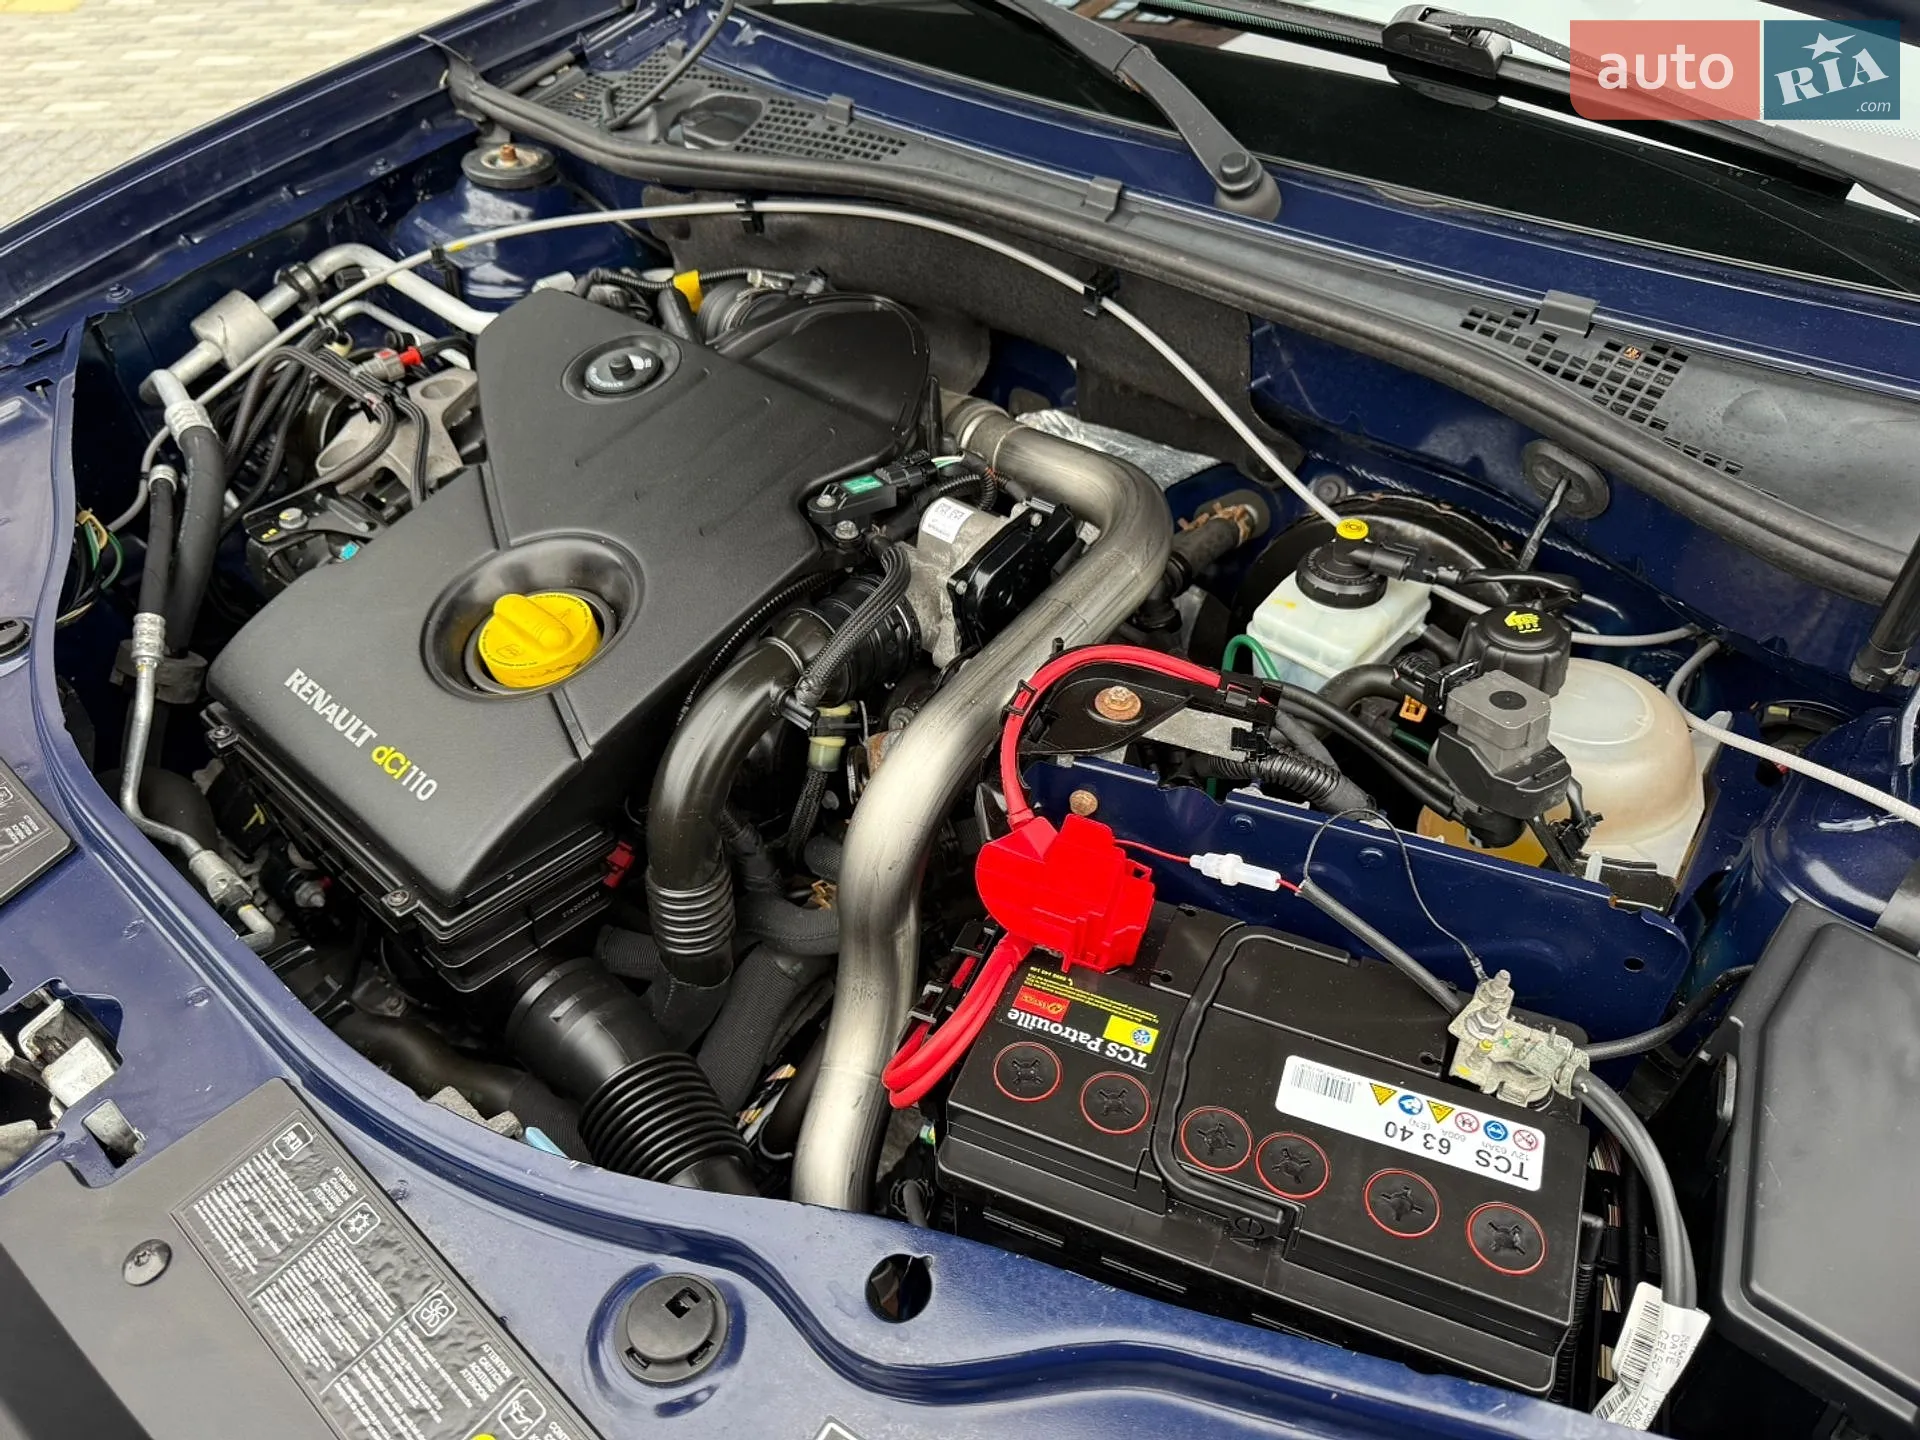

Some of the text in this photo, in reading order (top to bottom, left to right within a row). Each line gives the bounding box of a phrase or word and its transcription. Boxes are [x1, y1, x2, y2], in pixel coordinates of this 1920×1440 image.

[284, 668, 378, 748] RENAULT
[1007, 1008, 1103, 1052] Patrouille
[1105, 1042, 1146, 1068] TCS
[1383, 1120, 1531, 1180] TCS 63 40
